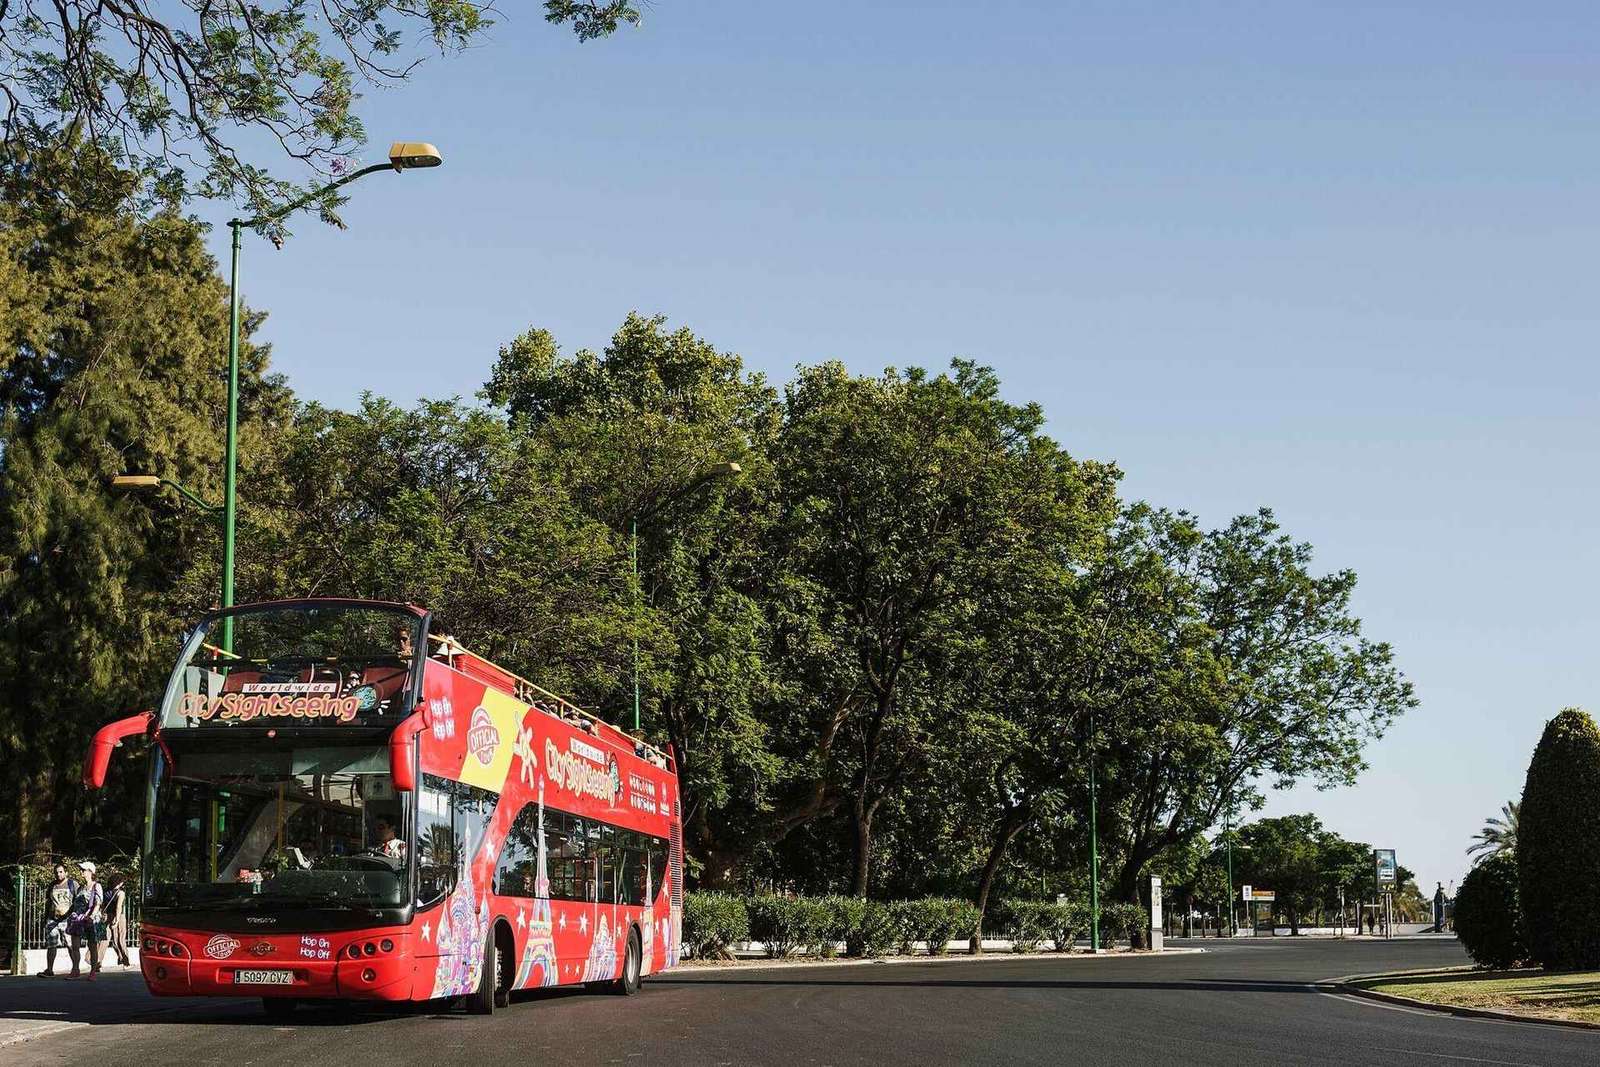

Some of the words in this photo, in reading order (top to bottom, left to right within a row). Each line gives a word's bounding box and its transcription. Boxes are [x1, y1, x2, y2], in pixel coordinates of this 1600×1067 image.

[246, 684, 332, 692] Worldwide
[470, 728, 498, 753] OFFICIAL
[207, 941, 237, 954] OFFICIAL
[301, 936, 317, 947] Hop
[318, 938, 330, 948] On
[300, 947, 316, 959] Hop
[317, 949, 331, 960] Off
[243, 971, 268, 983] 5097
